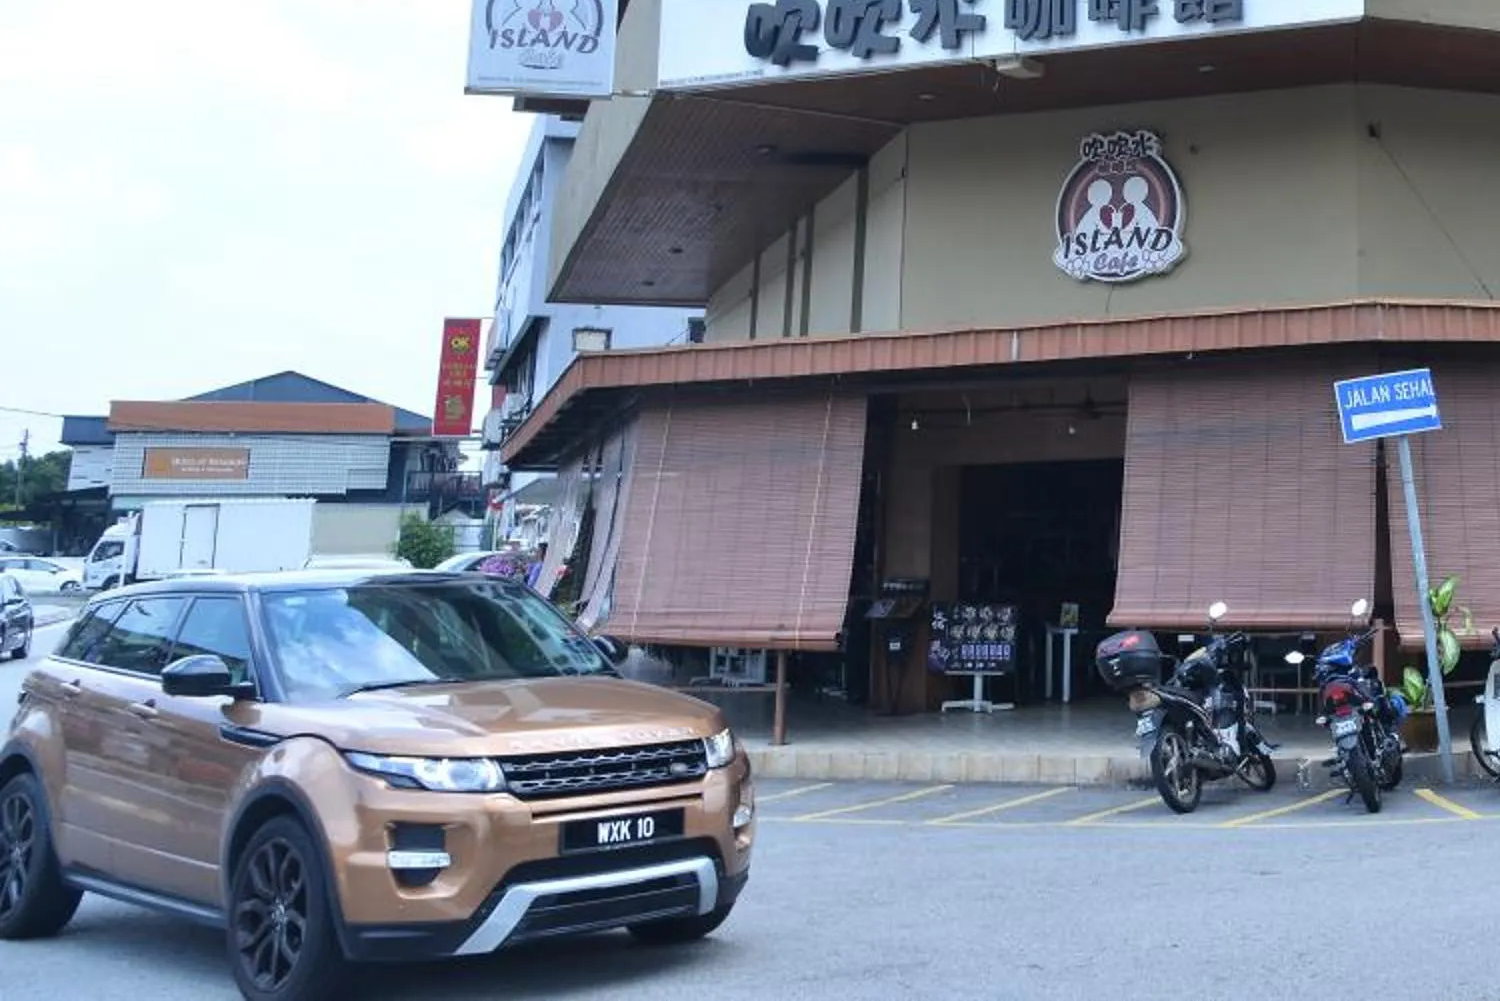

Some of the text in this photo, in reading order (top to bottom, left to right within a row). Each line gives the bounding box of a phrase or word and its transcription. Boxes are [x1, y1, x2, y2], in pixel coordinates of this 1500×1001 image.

[489, 26, 600, 54] ISLAND
[1063, 226, 1174, 259] ISLAND
[1344, 382, 1391, 409] JALAN
[598, 816, 655, 844] WXK 10
